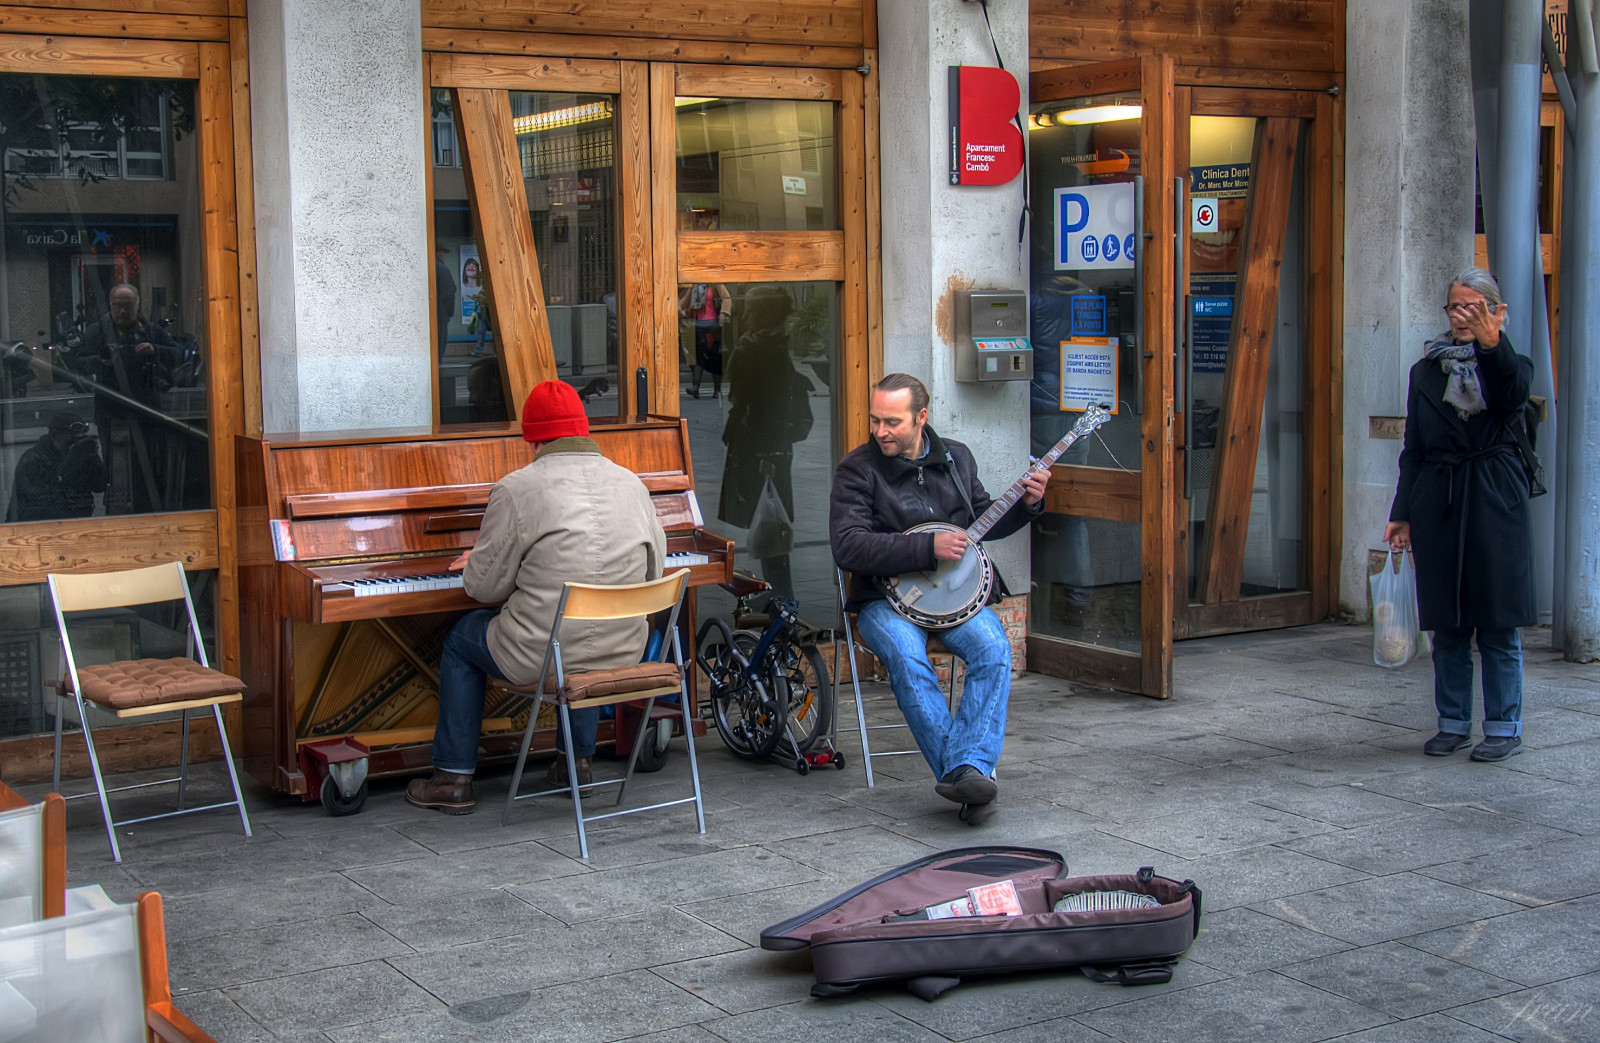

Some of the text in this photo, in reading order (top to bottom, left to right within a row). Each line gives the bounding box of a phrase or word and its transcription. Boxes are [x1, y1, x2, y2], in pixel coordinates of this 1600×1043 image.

[966, 142, 1005, 153] Aparcament
[966, 153, 995, 162] Francesc
[966, 162, 989, 171] Cambó
[1061, 193, 1089, 263] P
